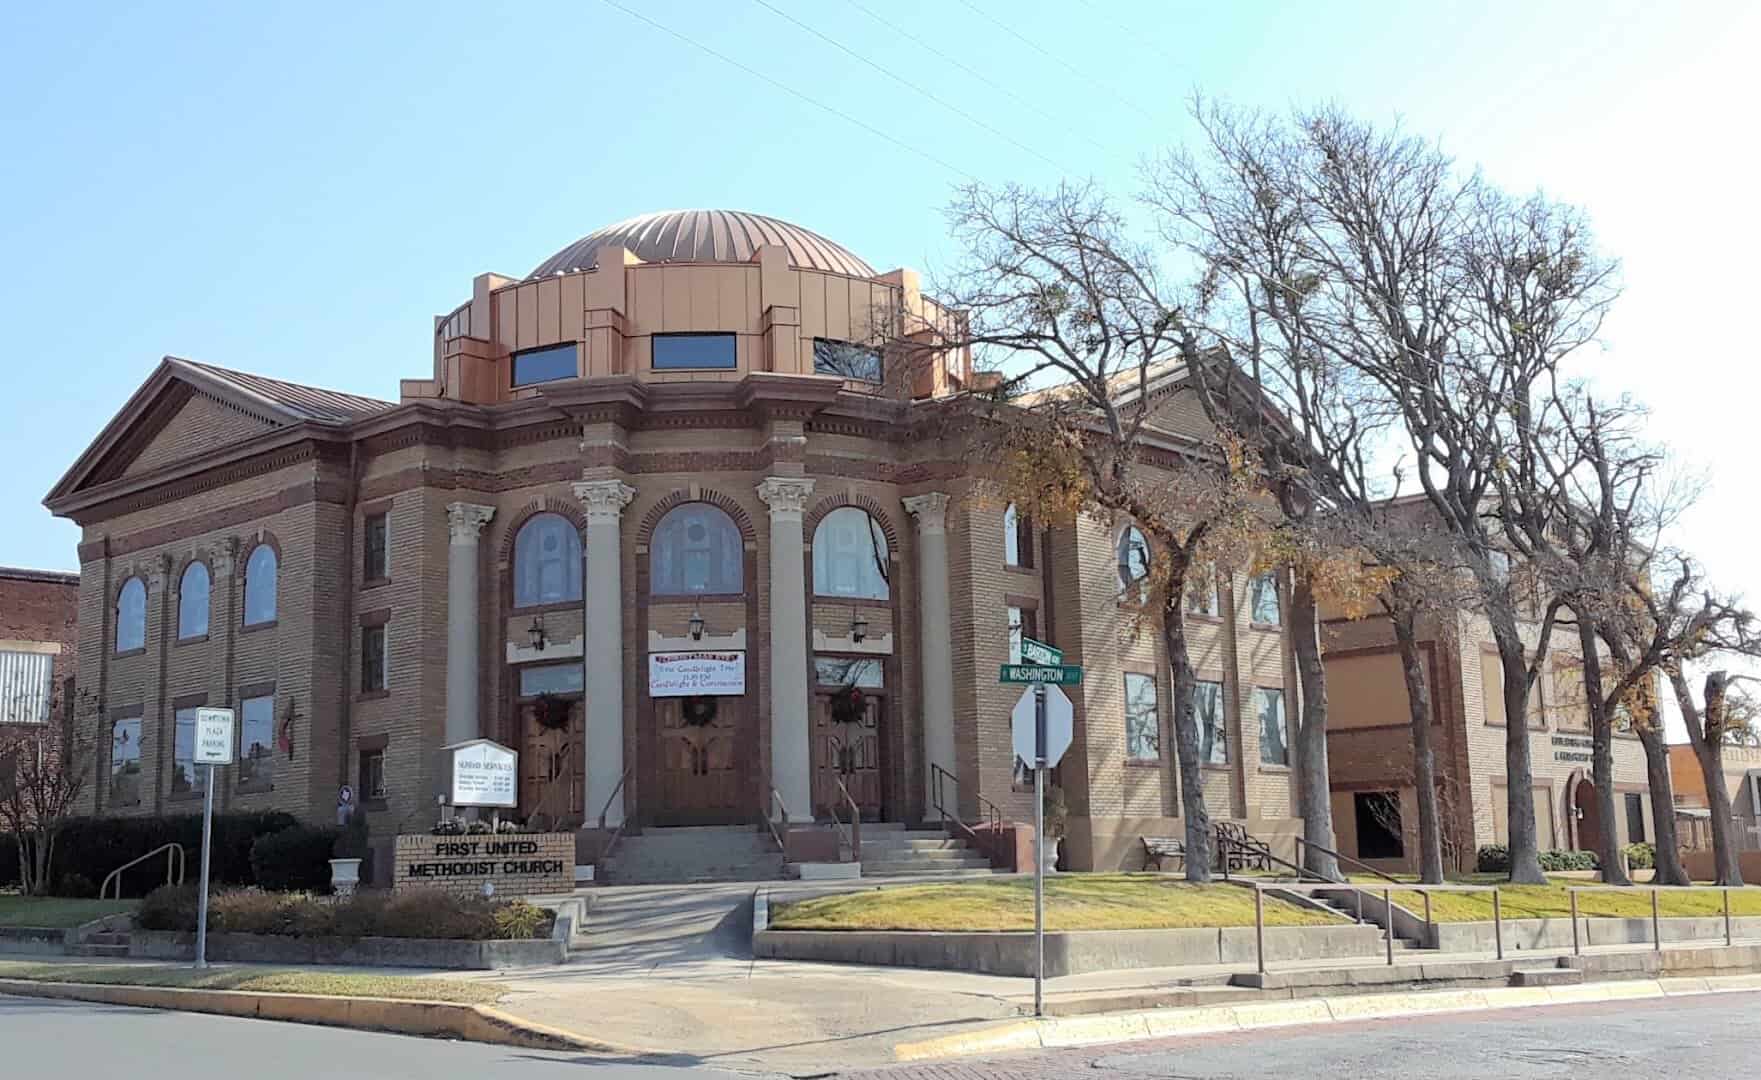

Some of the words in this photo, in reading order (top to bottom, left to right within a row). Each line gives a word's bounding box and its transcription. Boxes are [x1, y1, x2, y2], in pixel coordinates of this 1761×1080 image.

[1009, 668, 1064, 681] WASHINGTON
[436, 842, 477, 856] FIRST
[486, 841, 538, 855] UNITED
[409, 862, 496, 877] METHODIST
[504, 860, 563, 874] CHURCH
